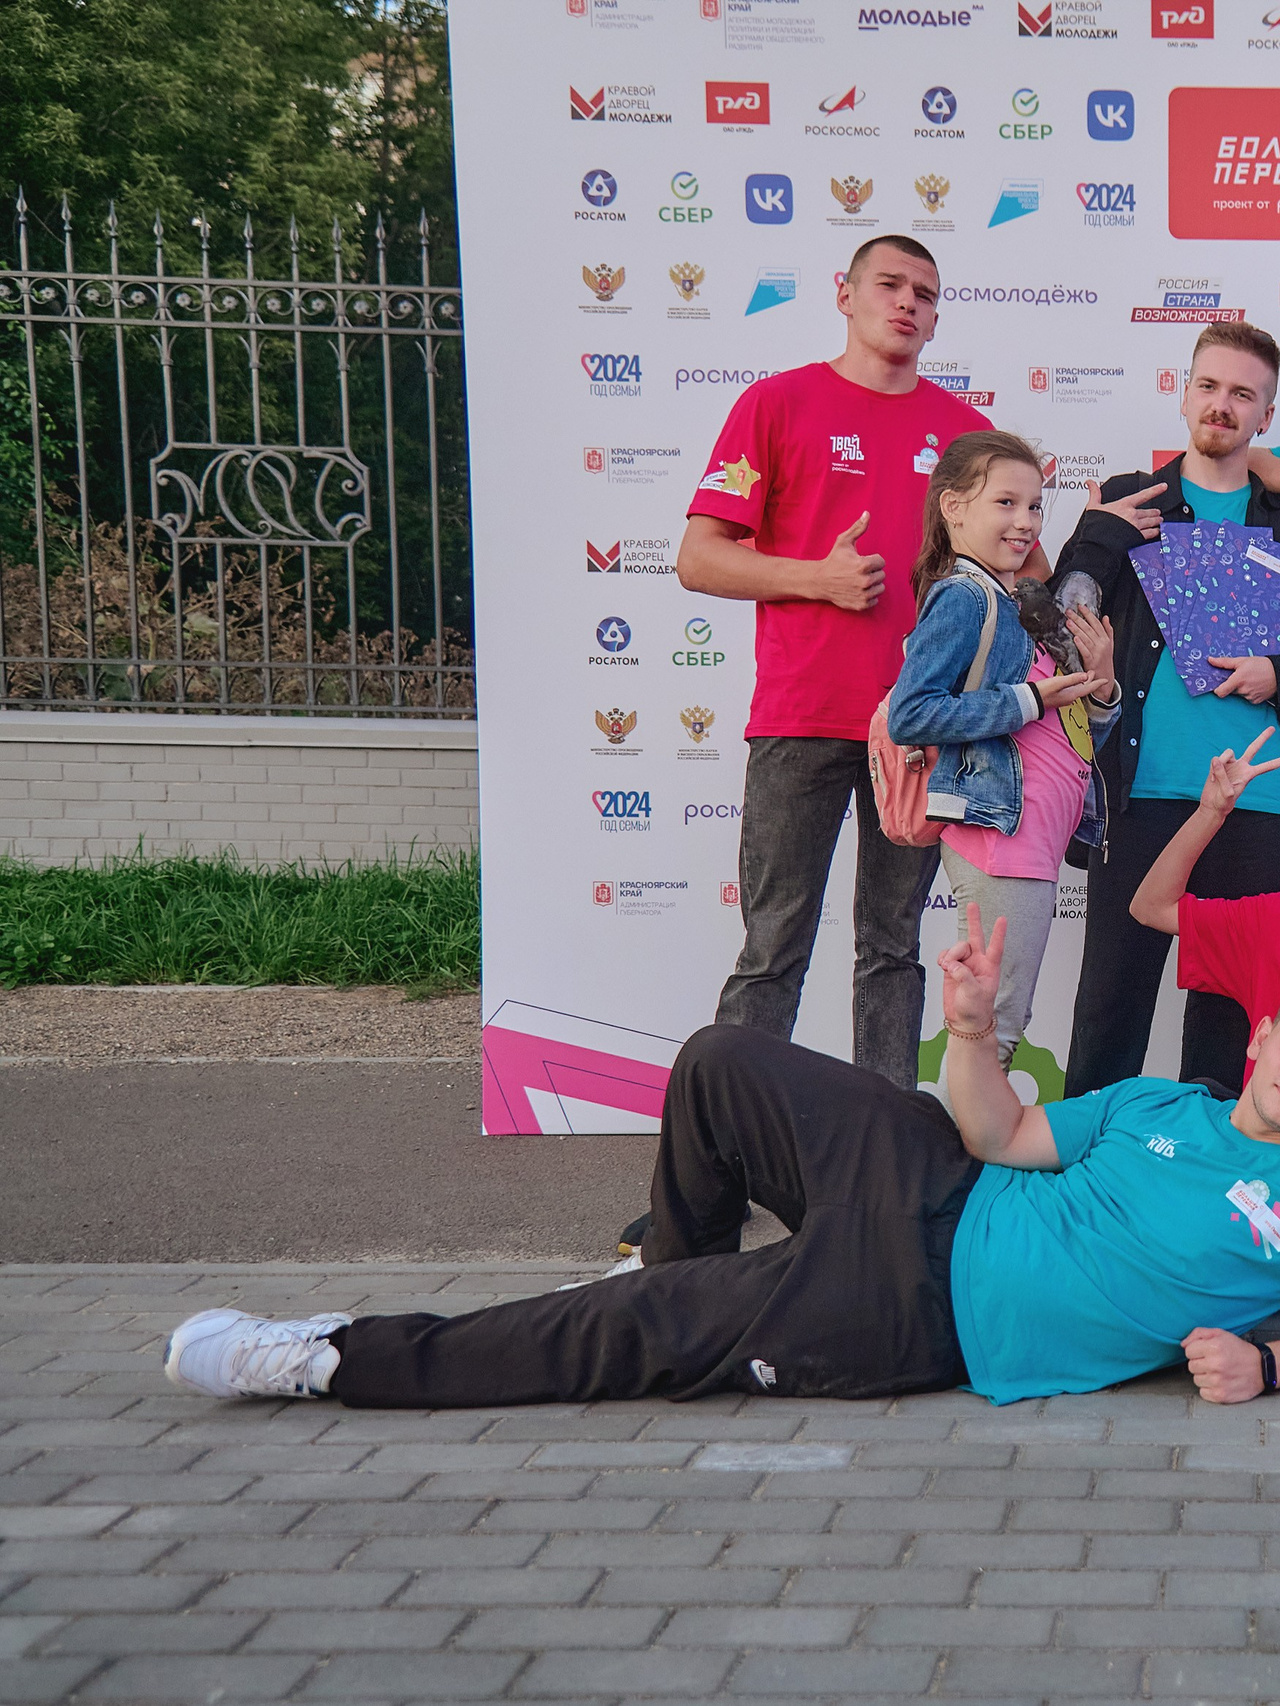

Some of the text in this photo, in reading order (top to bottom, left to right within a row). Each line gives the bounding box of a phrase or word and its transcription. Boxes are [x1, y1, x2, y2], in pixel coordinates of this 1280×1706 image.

[728, 2, 751, 12] КРАЙ
[1055, 1, 1103, 11] КРАЕВОЙ
[1055, 15, 1096, 26] ДВОРЕЦ
[1056, 29, 1117, 39] МОЛОДЕЖИ
[608, 85, 656, 96] КРАЕВОЙ
[608, 99, 650, 110] ДВОРЕЦ
[609, 113, 672, 123] МОЛОДЕЖИ
[1094, 104, 1128, 128] VK
[805, 126, 880, 136] РОСКОСМОС
[915, 129, 964, 138] РОСАТОМ
[999, 124, 1052, 140] СБЕР
[752, 187, 786, 212] VK
[1085, 183, 1136, 212] 2024
[1213, 200, 1253, 211] проект
[1256, 200, 1270, 209] от
[575, 212, 626, 221] РОСАТОМ
[659, 207, 712, 223] СБЕР
[1084, 214, 1101, 227] ГОД
[1158, 279, 1207, 290] РОССИЯ
[938, 284, 1098, 305] осмолодёжь
[1166, 294, 1216, 306] СТРАНА
[1134, 308, 1239, 323] ВОЗМОЖНОСТЕЙ
[590, 354, 642, 383] 2024
[917, 362, 958, 372] ОССИЯ
[1055, 367, 1124, 376] КРАСНОЯРСКИЙ
[1055, 376, 1078, 384] КРАЙ
[590, 384, 608, 398] ГОД
[611, 447, 681, 457] КРАСНОЯРСКИЙ
[611, 457, 634, 465] КРАЙ
[1059, 454, 1105, 465] КРАЕВОЙ
[1059, 467, 1099, 478] ДВОРЕЦ
[624, 539, 669, 549] КРАЕВОЙ
[624, 552, 664, 562] ДВОРЕЦ
[624, 564, 677, 575] МОЛОДЕЖ
[589, 657, 639, 665] РОСАТОМ
[672, 652, 725, 666] СБЕР
[601, 791, 651, 818] 2024
[601, 820, 618, 833] ГОД
[620, 880, 688, 889] КРАСНОЯРСКИЙ
[620, 890, 642, 898] КРАЙ
[1060, 898, 1086, 907] ДВОР
